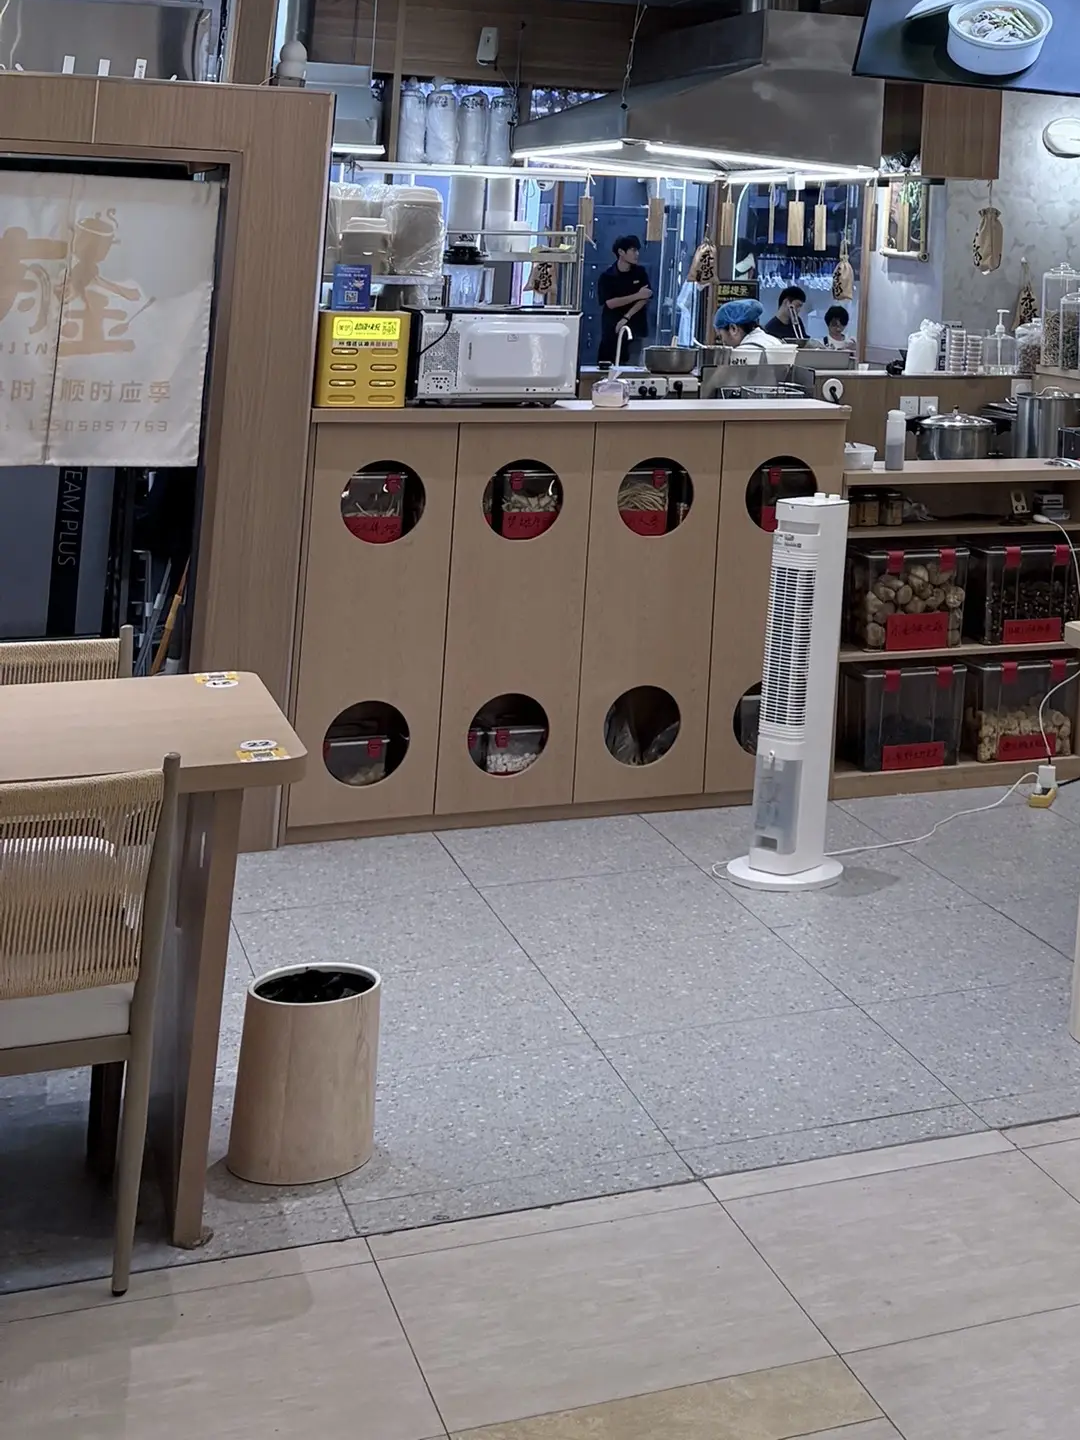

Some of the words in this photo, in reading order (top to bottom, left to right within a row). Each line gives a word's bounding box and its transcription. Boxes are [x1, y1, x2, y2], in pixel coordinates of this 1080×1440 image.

[0, 341, 48, 355] JIN
[0, 378, 36, 403] 时
[59, 378, 171, 403] 顺时应季
[57, 519, 79, 566] PLUS
